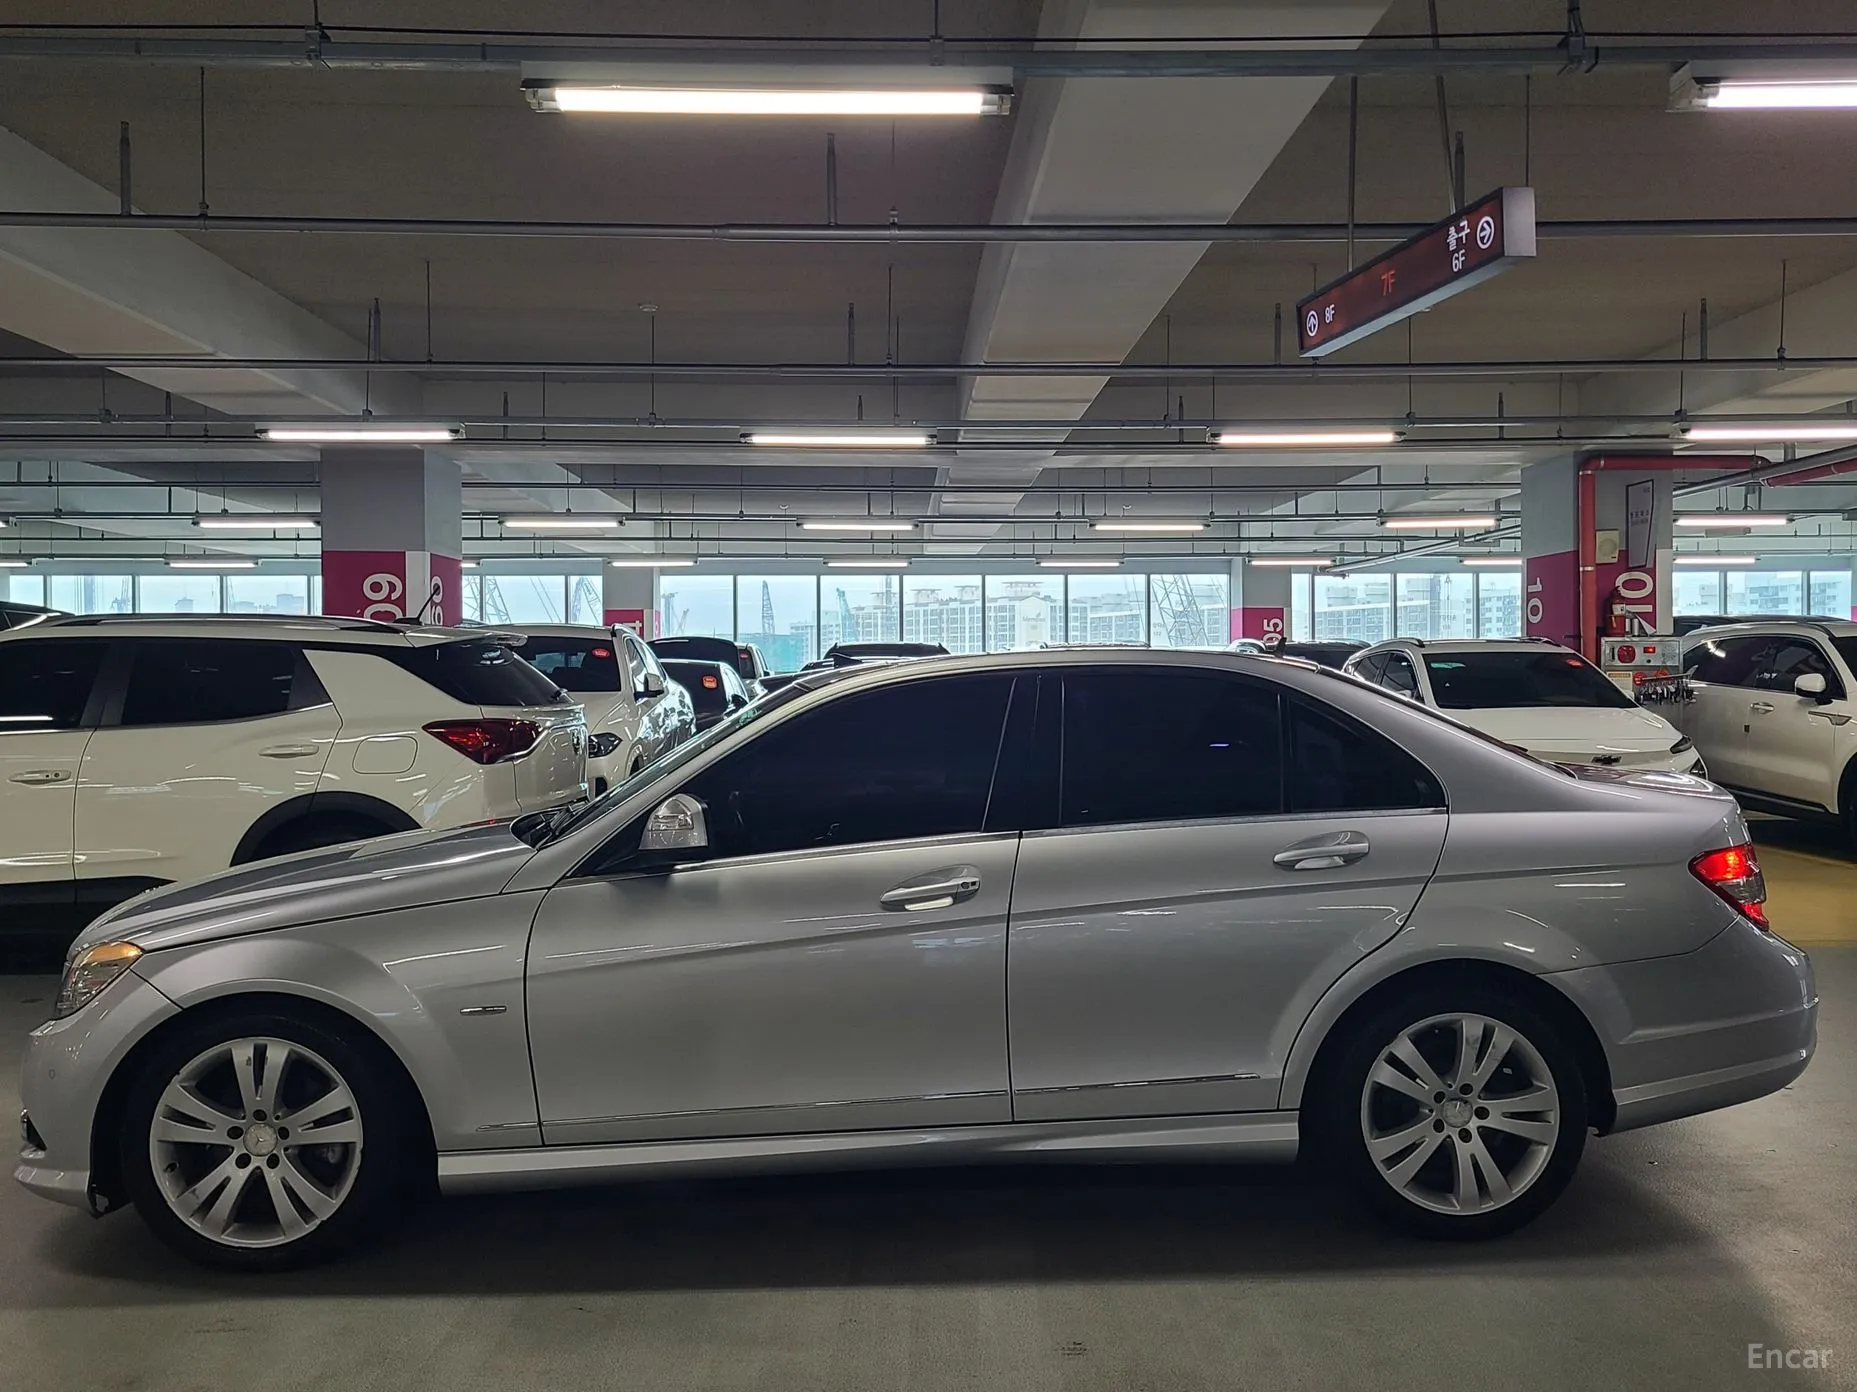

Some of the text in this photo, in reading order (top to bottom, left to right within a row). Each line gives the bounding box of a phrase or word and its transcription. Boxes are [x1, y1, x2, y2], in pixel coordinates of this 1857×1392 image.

[1446, 219, 1471, 250] 출구
[1452, 250, 1466, 272] 6F
[1380, 270, 1396, 296] 7F
[1324, 304, 1335, 324] 8F
[1527, 577, 1543, 624] 10
[1262, 618, 1283, 646] 05
